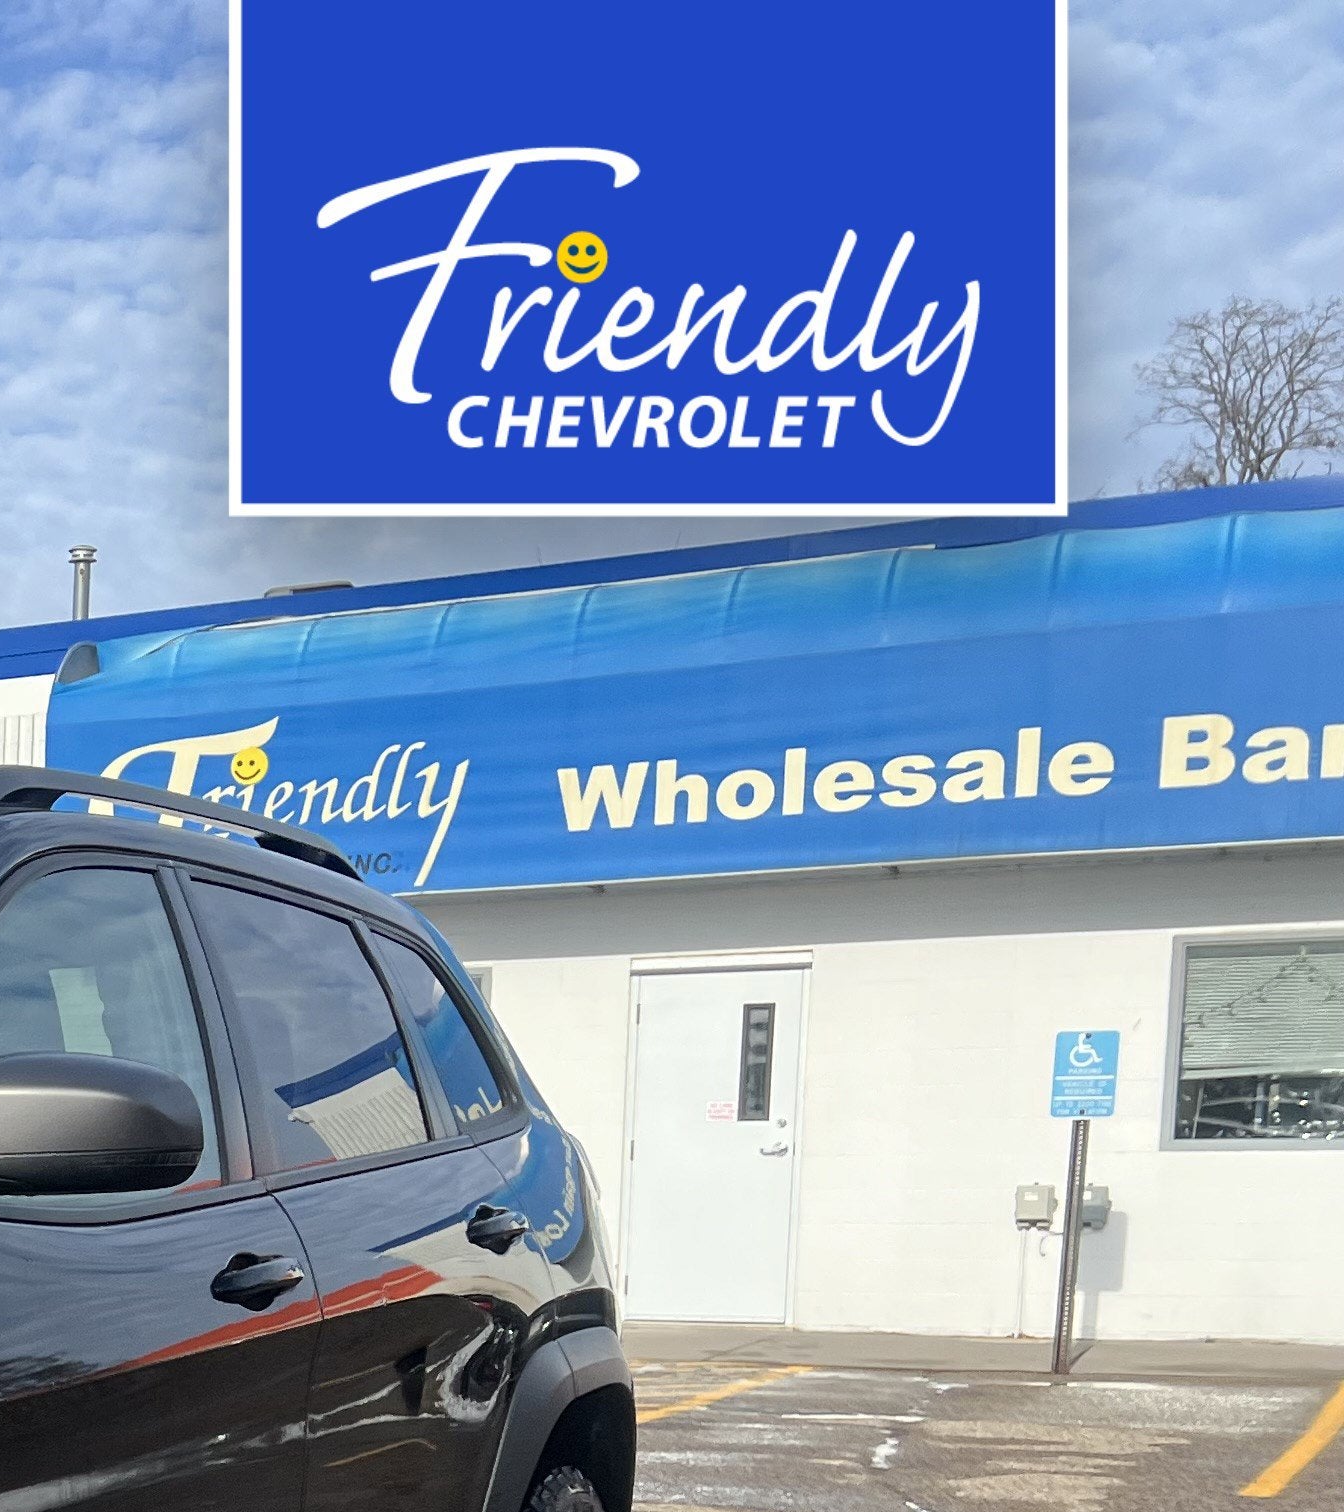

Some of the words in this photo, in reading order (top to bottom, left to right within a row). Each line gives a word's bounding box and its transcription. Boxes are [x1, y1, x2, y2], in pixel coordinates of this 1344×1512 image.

[88, 716, 470, 888] Friendly
[556, 727, 1114, 832] Wholesale
[348, 851, 400, 875] NC.
